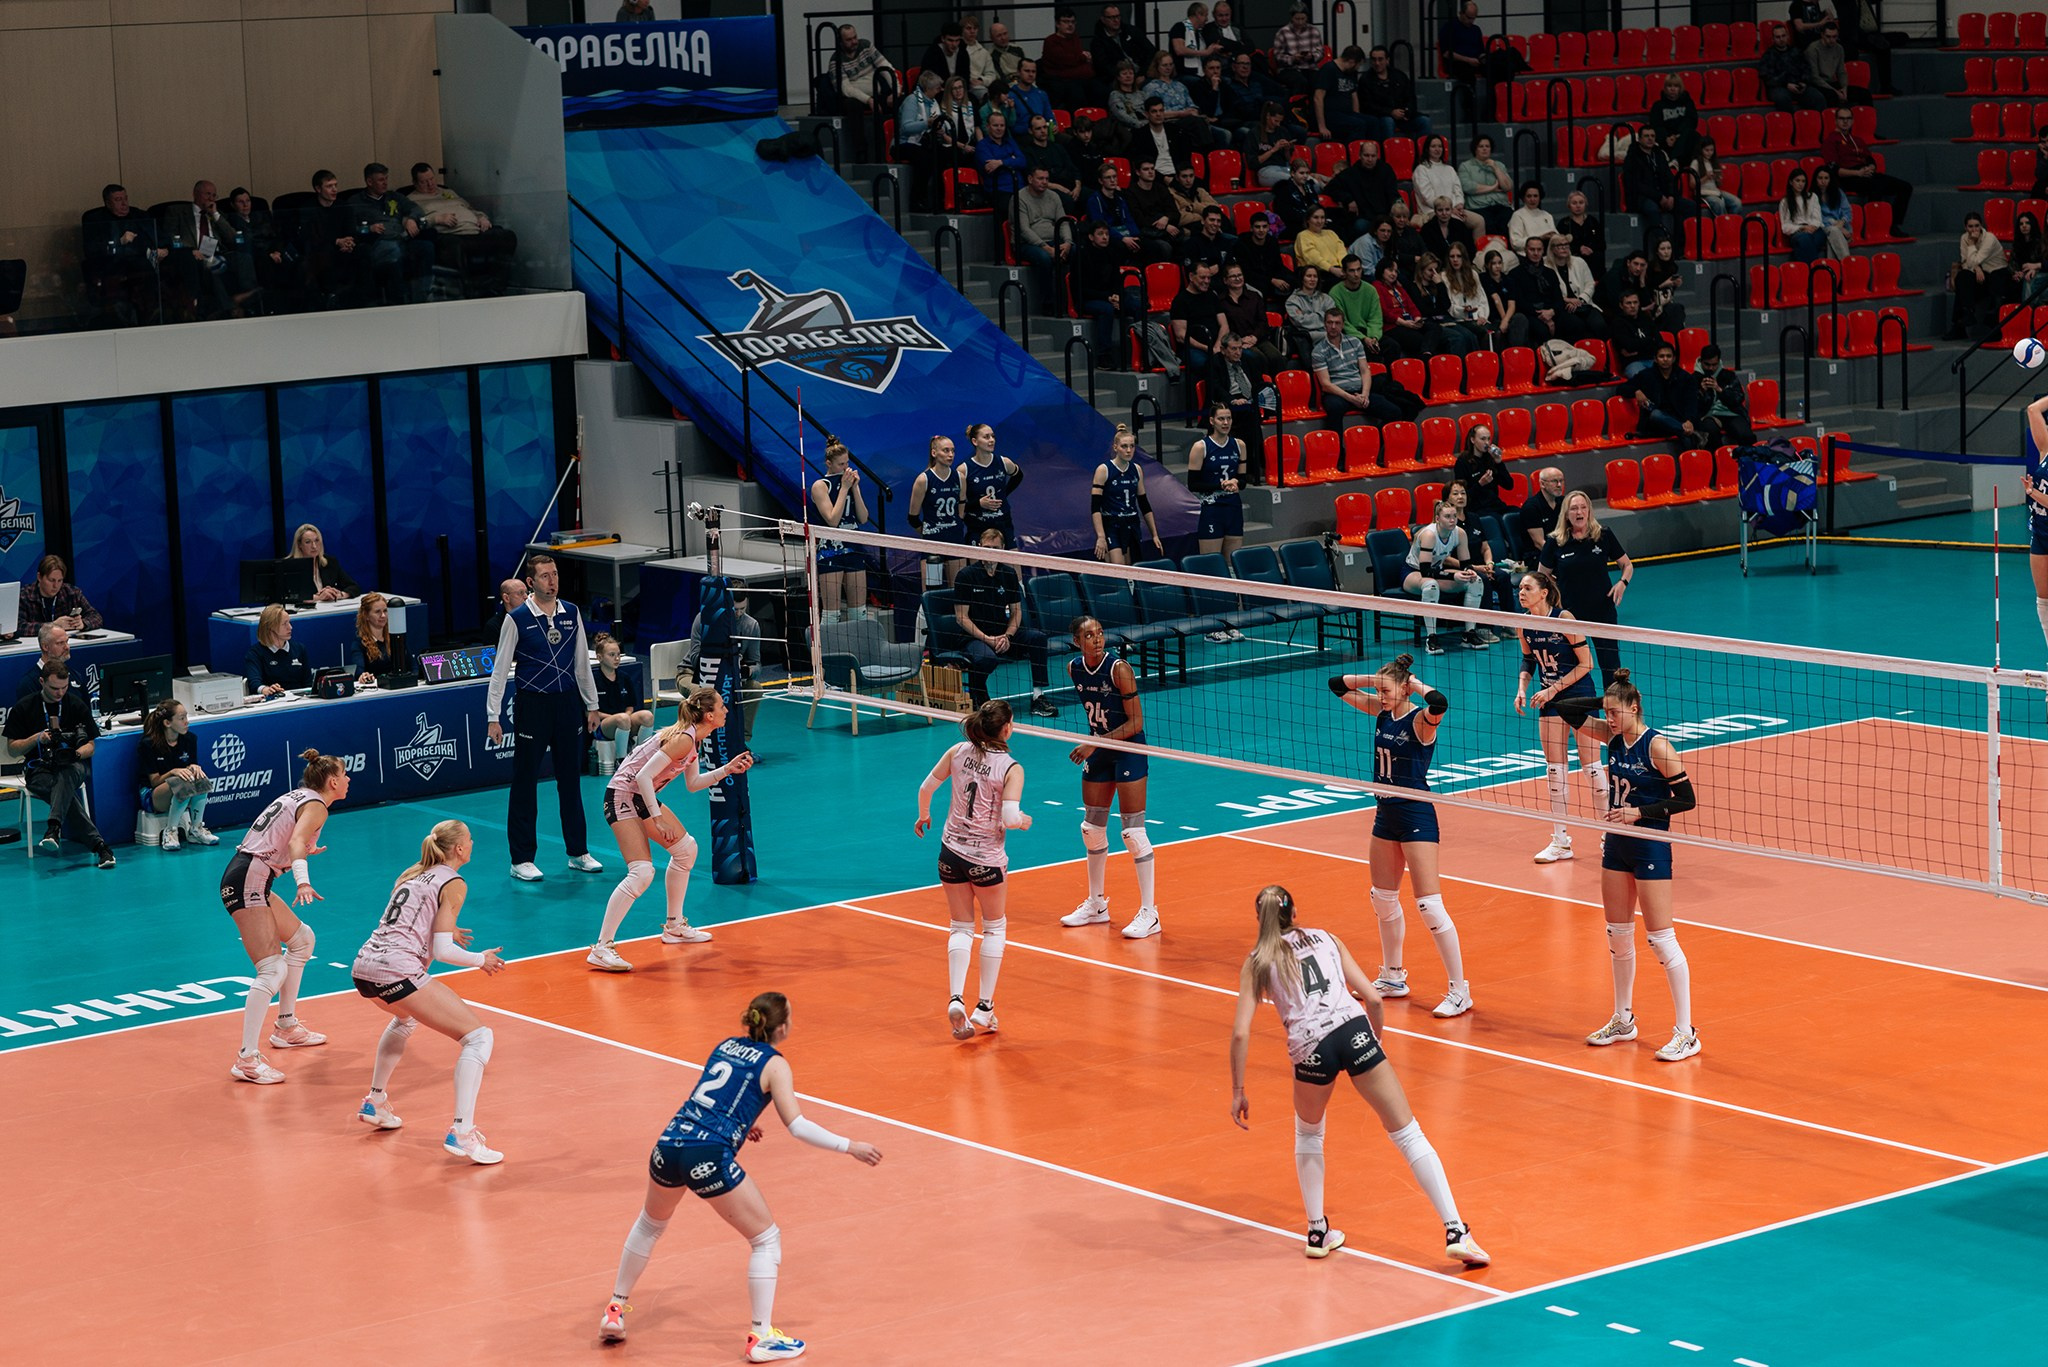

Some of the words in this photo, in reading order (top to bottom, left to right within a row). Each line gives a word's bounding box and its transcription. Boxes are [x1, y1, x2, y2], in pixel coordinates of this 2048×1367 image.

[527, 30, 712, 77] ОРАБЕЛКА
[935, 496, 957, 517] 20
[431, 662, 443, 680] 7
[481, 655, 495, 674] 9
[1533, 649, 1559, 674] 14
[1085, 701, 1108, 732] 24
[399, 743, 455, 764] КОРАБЕЛКА
[1377, 747, 1392, 778] 11
[1611, 774, 1632, 807] 12
[253, 801, 283, 832] 3
[387, 888, 410, 925] 8
[1300, 955, 1331, 998] 4
[691, 1060, 733, 1109] 2
